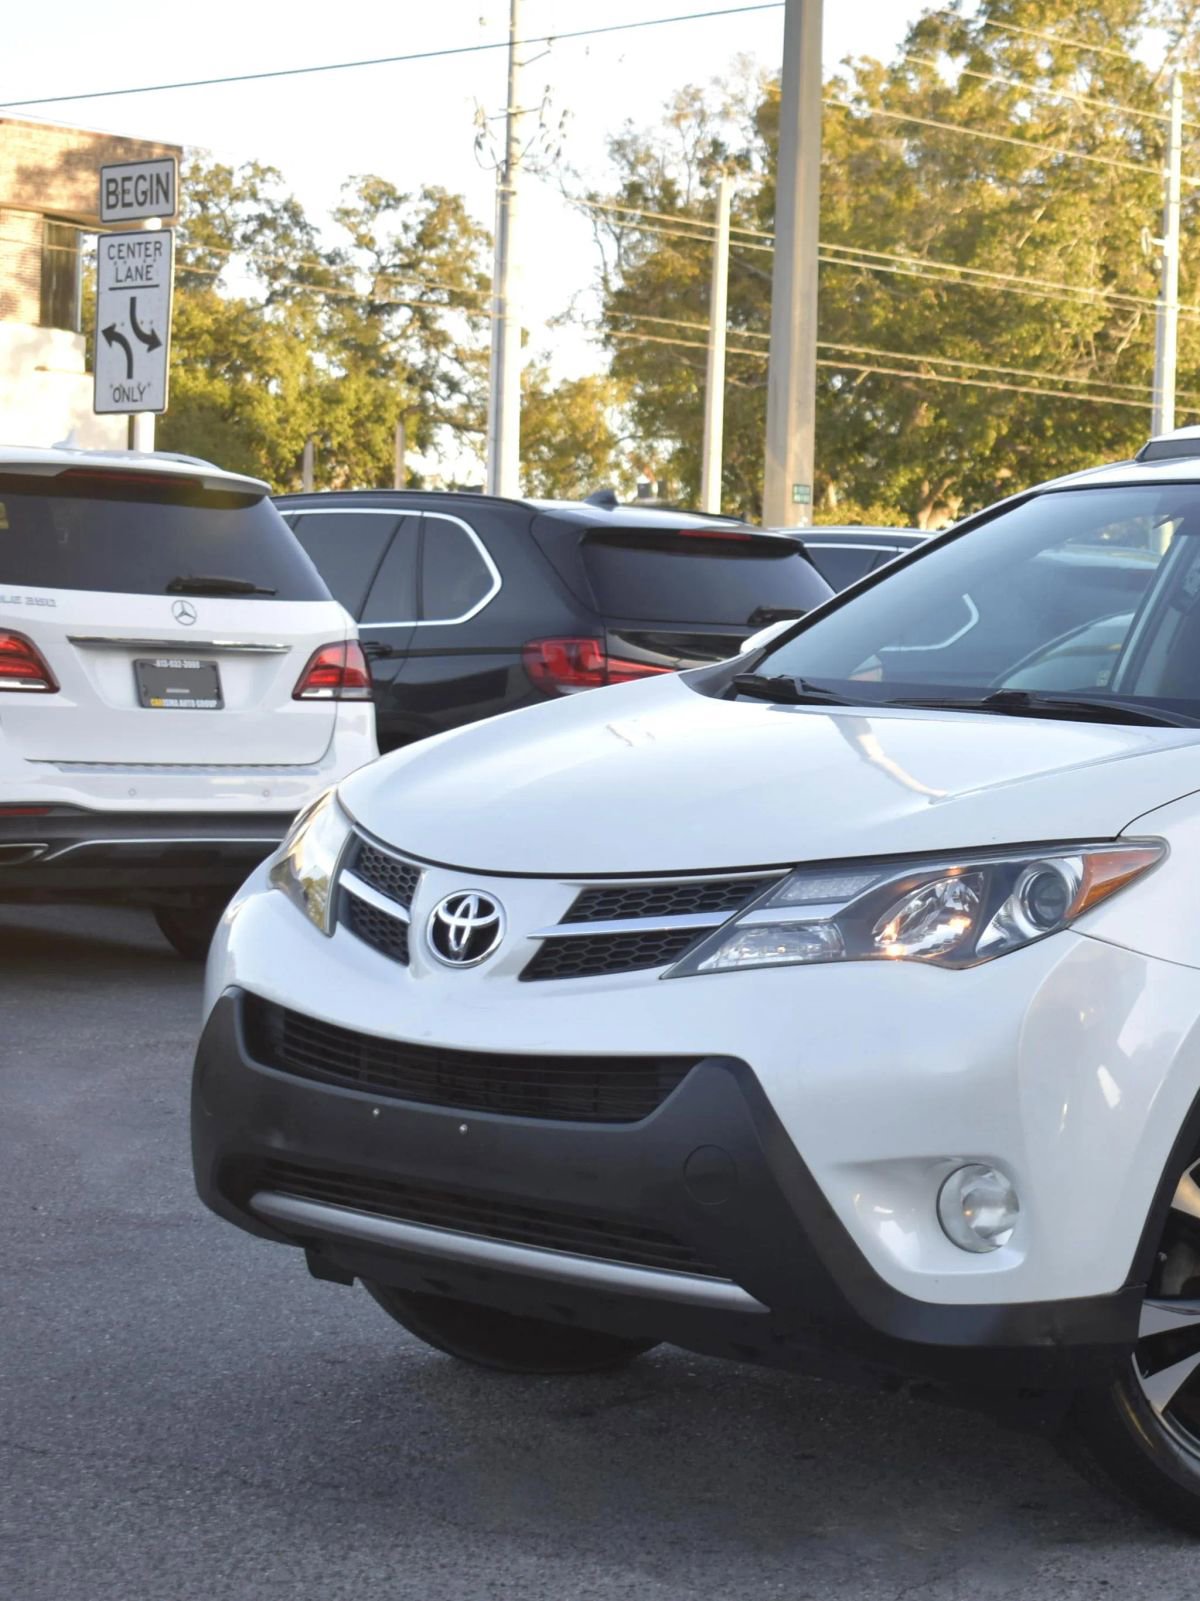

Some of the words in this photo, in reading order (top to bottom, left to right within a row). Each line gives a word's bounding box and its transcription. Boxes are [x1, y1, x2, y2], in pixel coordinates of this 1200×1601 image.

[105, 171, 170, 210] BEGIN
[107, 240, 163, 261] CENTER
[115, 264, 154, 283] LANE
[112, 385, 147, 404] ONLY
